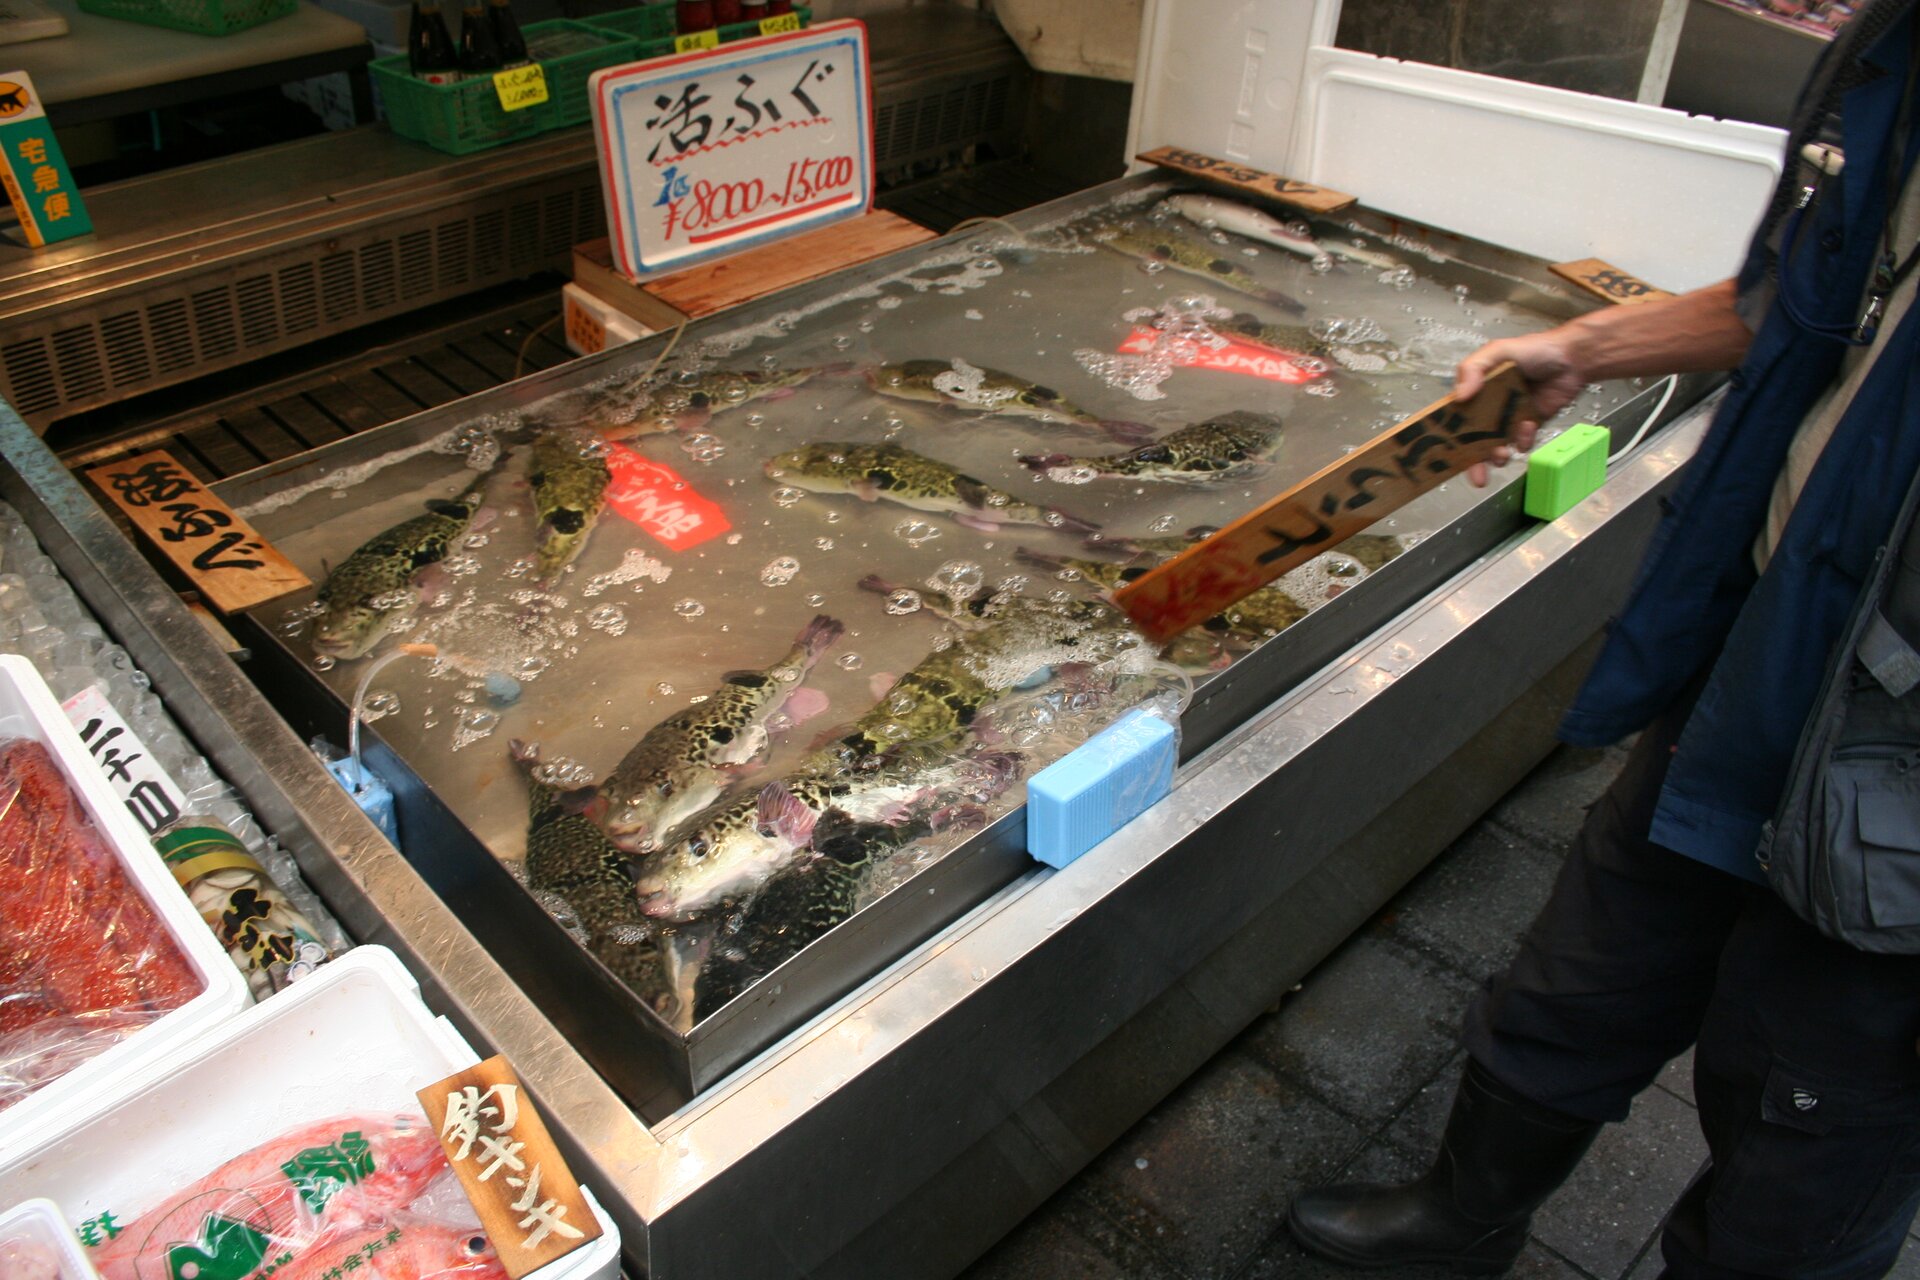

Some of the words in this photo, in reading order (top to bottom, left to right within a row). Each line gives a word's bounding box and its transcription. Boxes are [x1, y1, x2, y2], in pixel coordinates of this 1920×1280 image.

[646, 59, 835, 163] 活ふぐ
[18, 137, 73, 222] 宅急便
